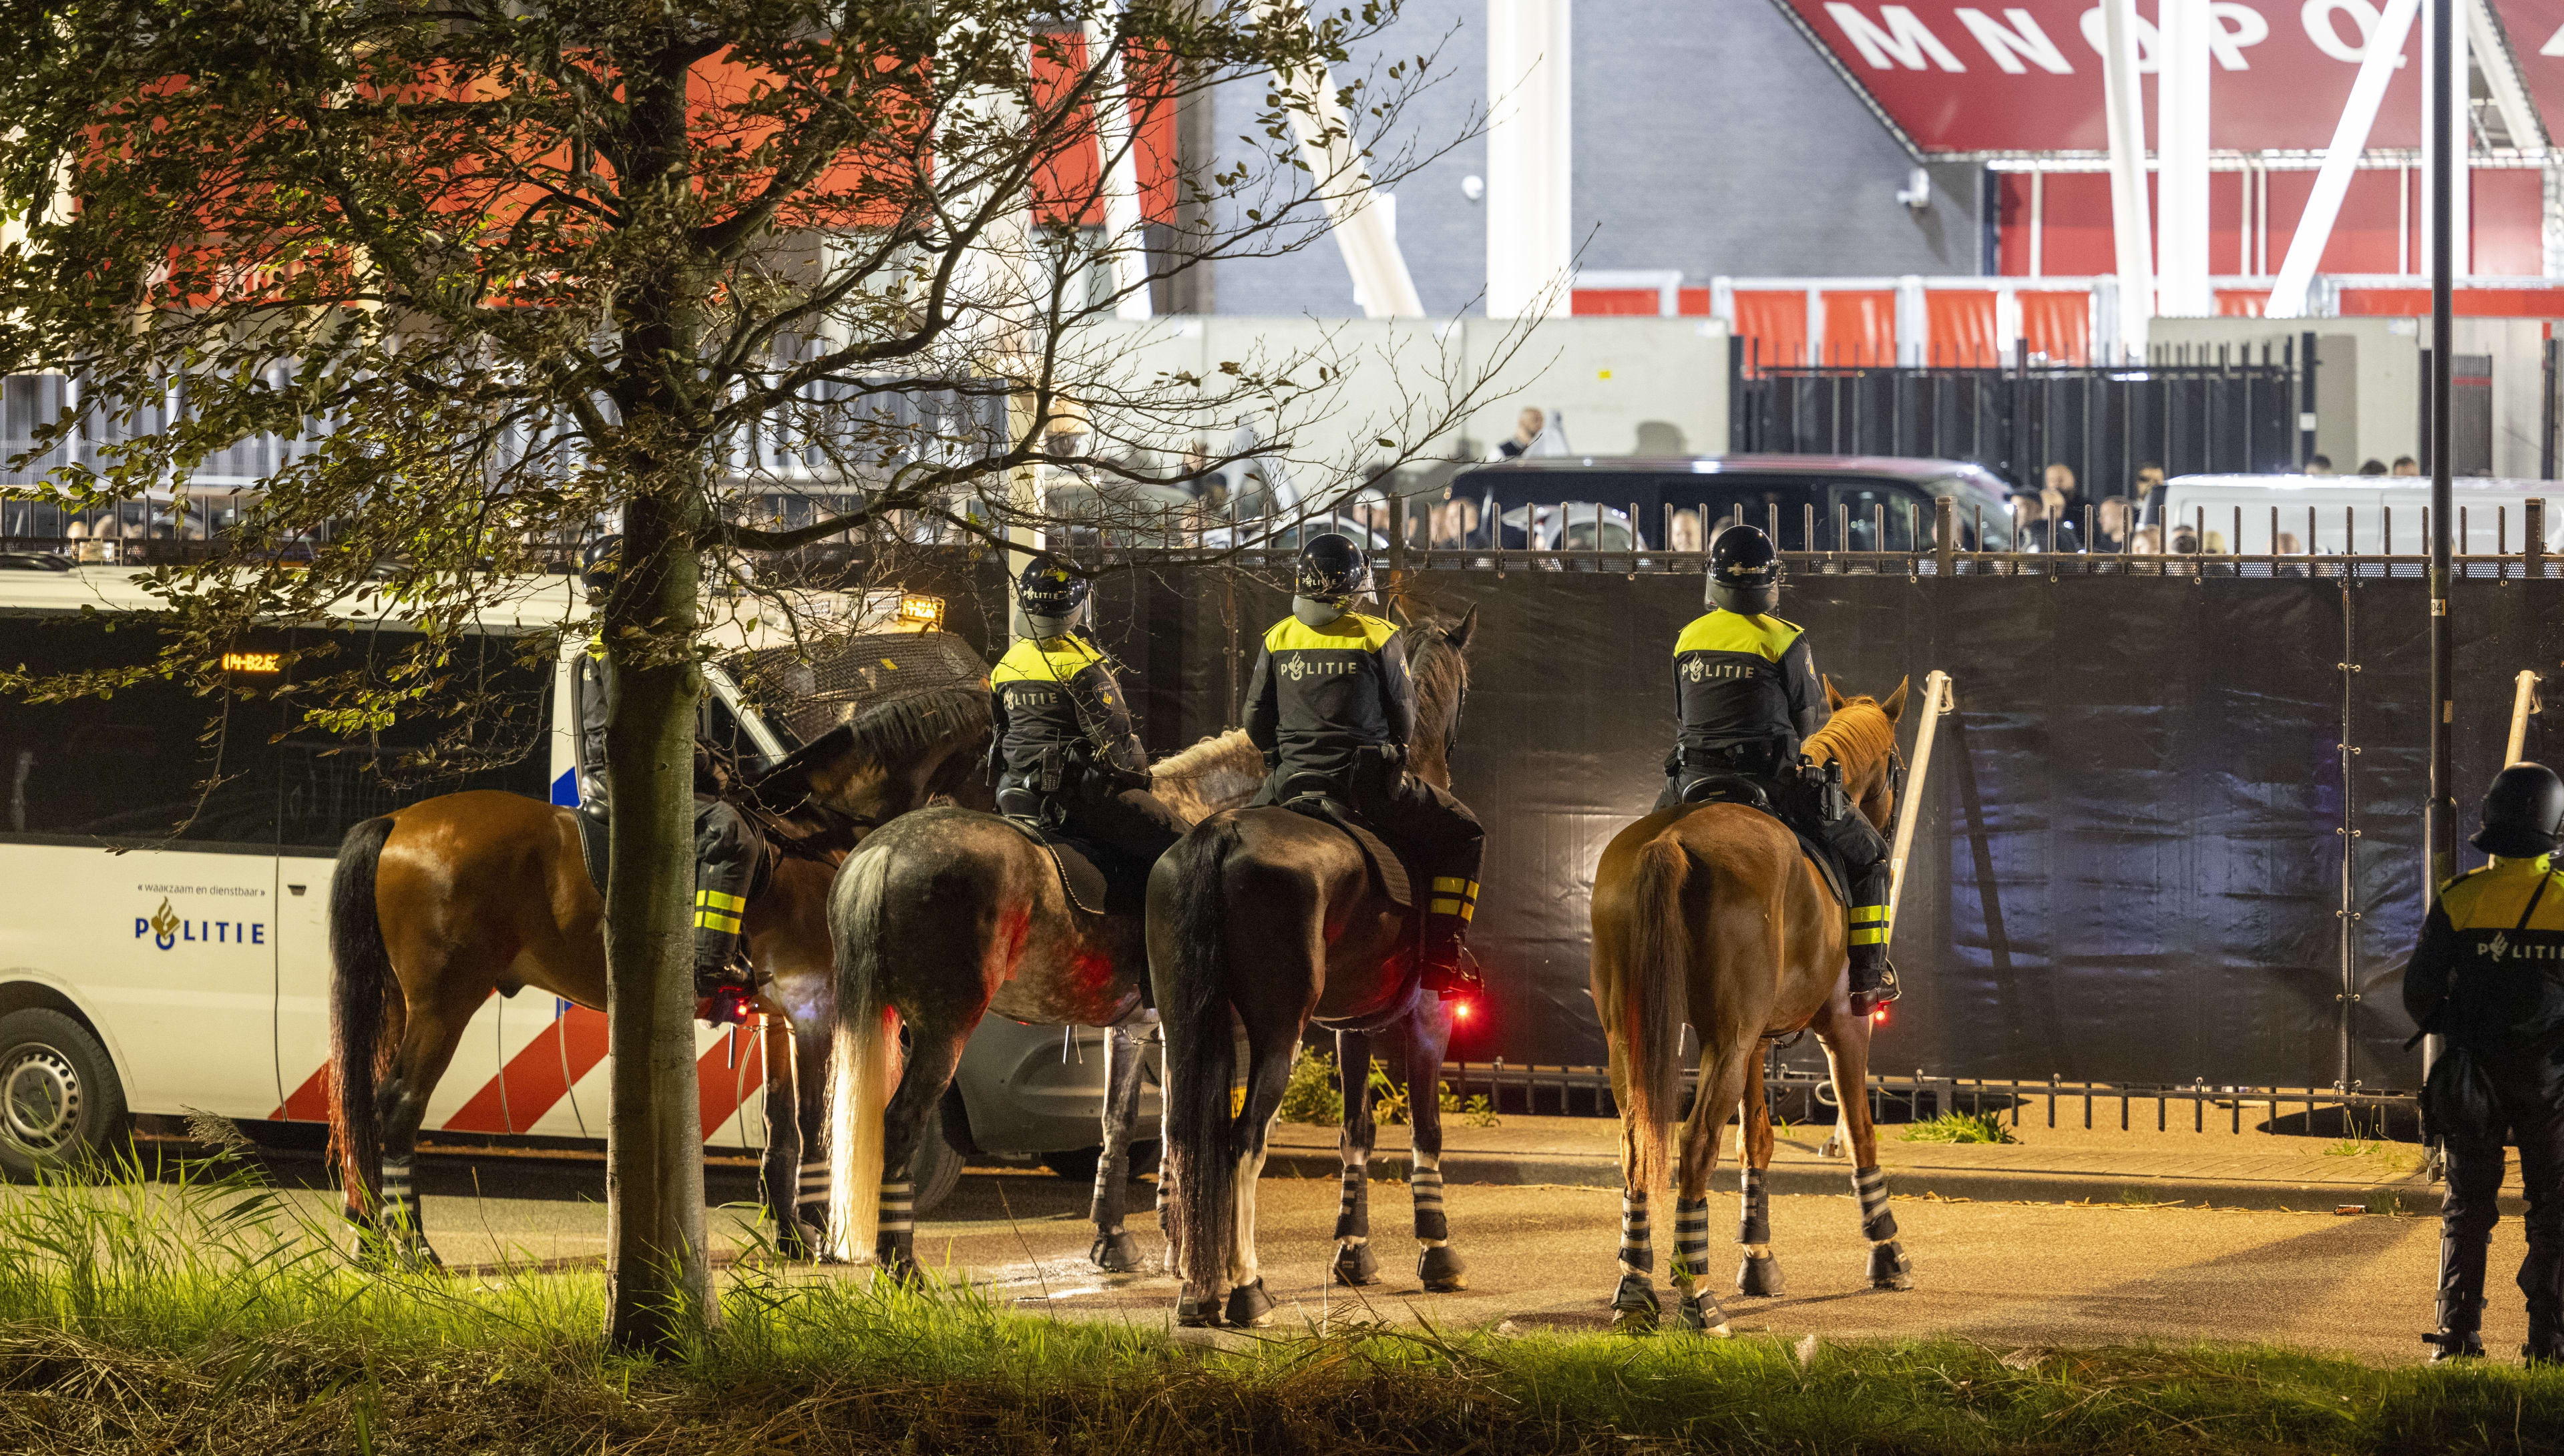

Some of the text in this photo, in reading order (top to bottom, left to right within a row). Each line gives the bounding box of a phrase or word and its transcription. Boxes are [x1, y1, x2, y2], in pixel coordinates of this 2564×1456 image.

[1281, 662, 1357, 681] POLITIE
[1682, 663, 1754, 682] POLITIE
[1004, 692, 1058, 710] OLITIE
[145, 883, 194, 894] waakzaam
[210, 885, 258, 897] dienstbaar
[135, 917, 264, 951] POLITIE
